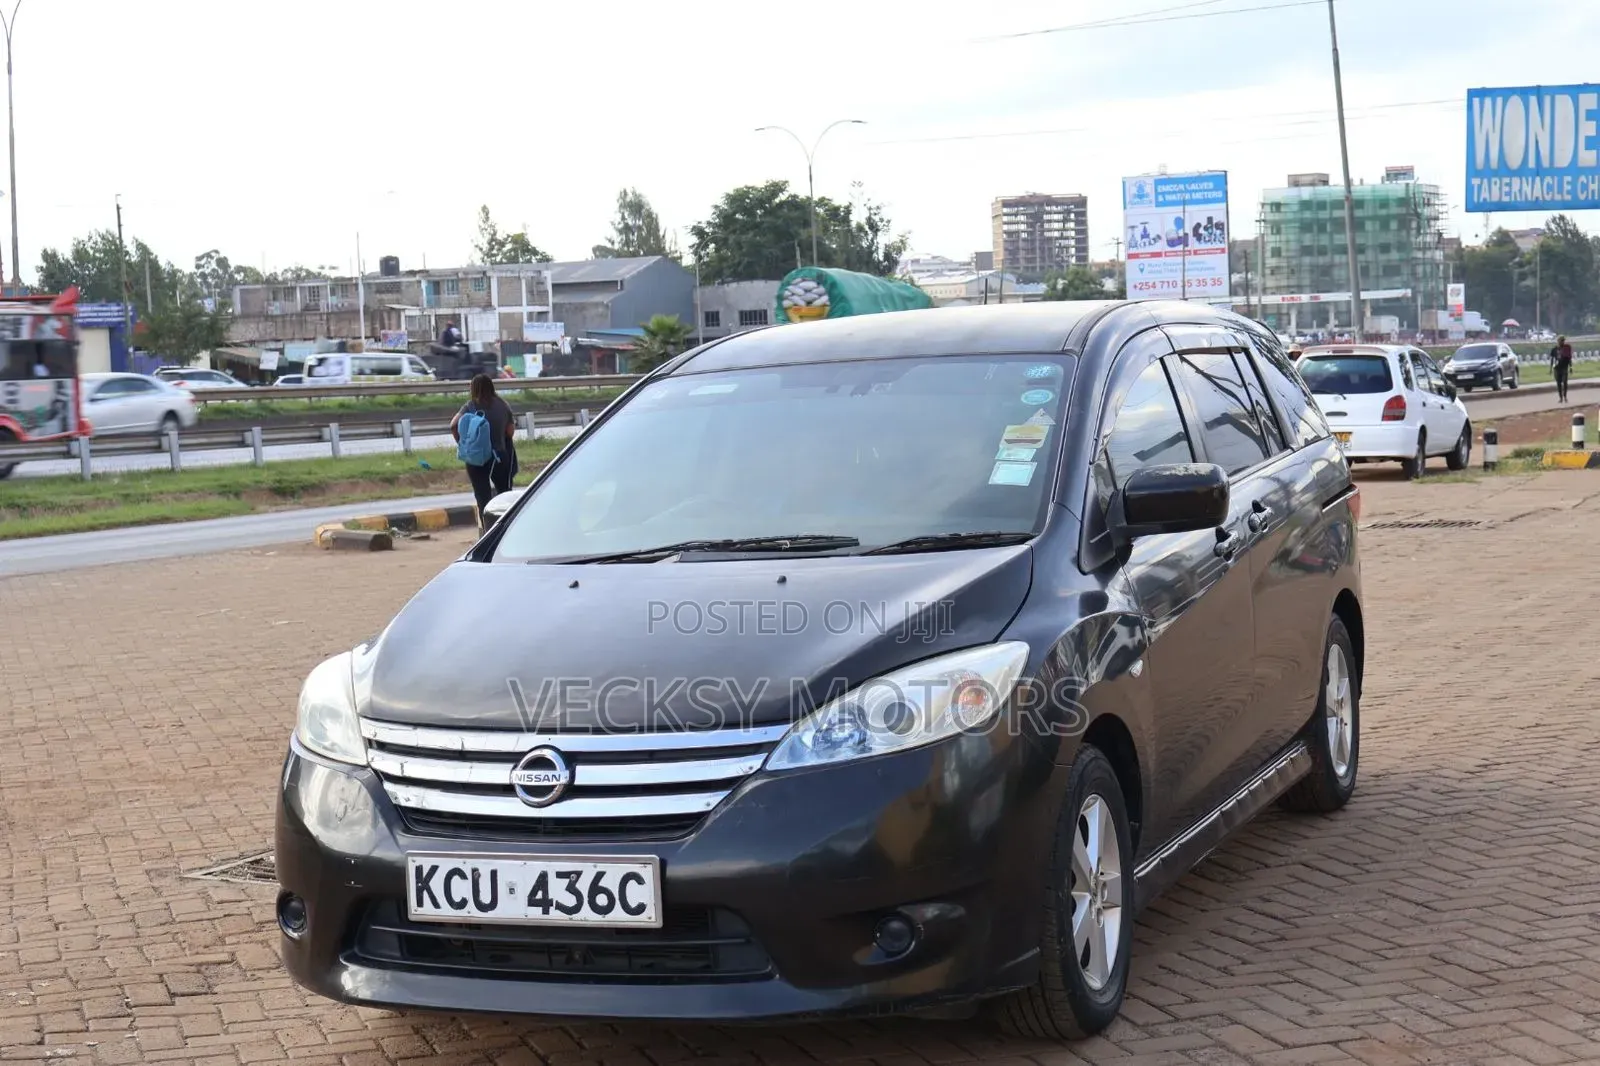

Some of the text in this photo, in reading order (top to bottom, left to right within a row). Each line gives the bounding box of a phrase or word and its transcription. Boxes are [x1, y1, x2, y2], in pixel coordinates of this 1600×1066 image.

[1471, 176, 1572, 203] TABERNACLE
[1133, 281, 1157, 291] +254
[1160, 280, 1178, 289] 710
[1195, 278, 1208, 288] 35
[1210, 277, 1223, 287] 35
[515, 773, 561, 783] NISSAN
[415, 864, 647, 916] KCU 436C
